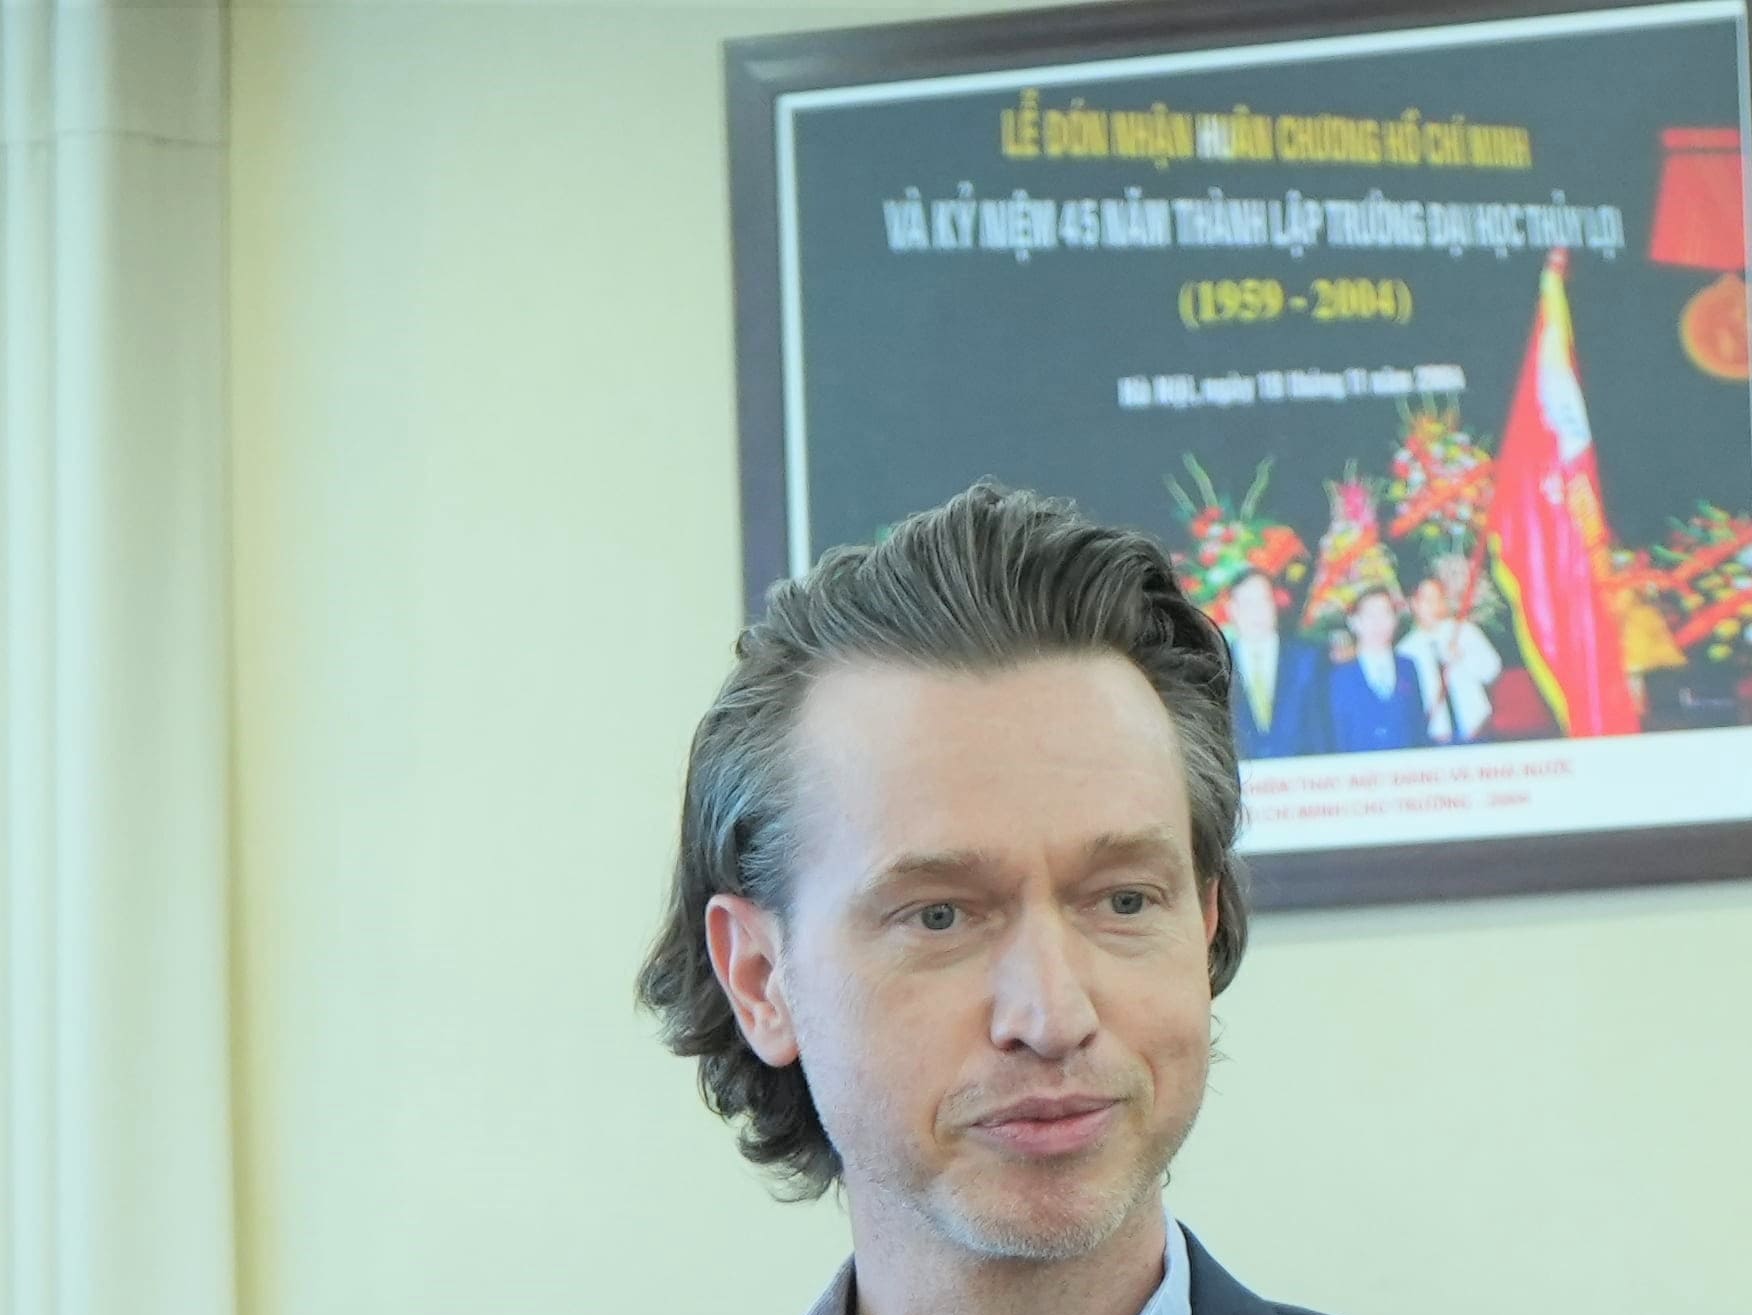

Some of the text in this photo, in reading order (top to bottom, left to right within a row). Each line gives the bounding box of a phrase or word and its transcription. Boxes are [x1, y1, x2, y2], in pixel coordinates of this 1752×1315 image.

[1058, 198, 1100, 250] 45
[1178, 278, 1285, 329] (1959
[1310, 278, 1412, 327] 2004)
